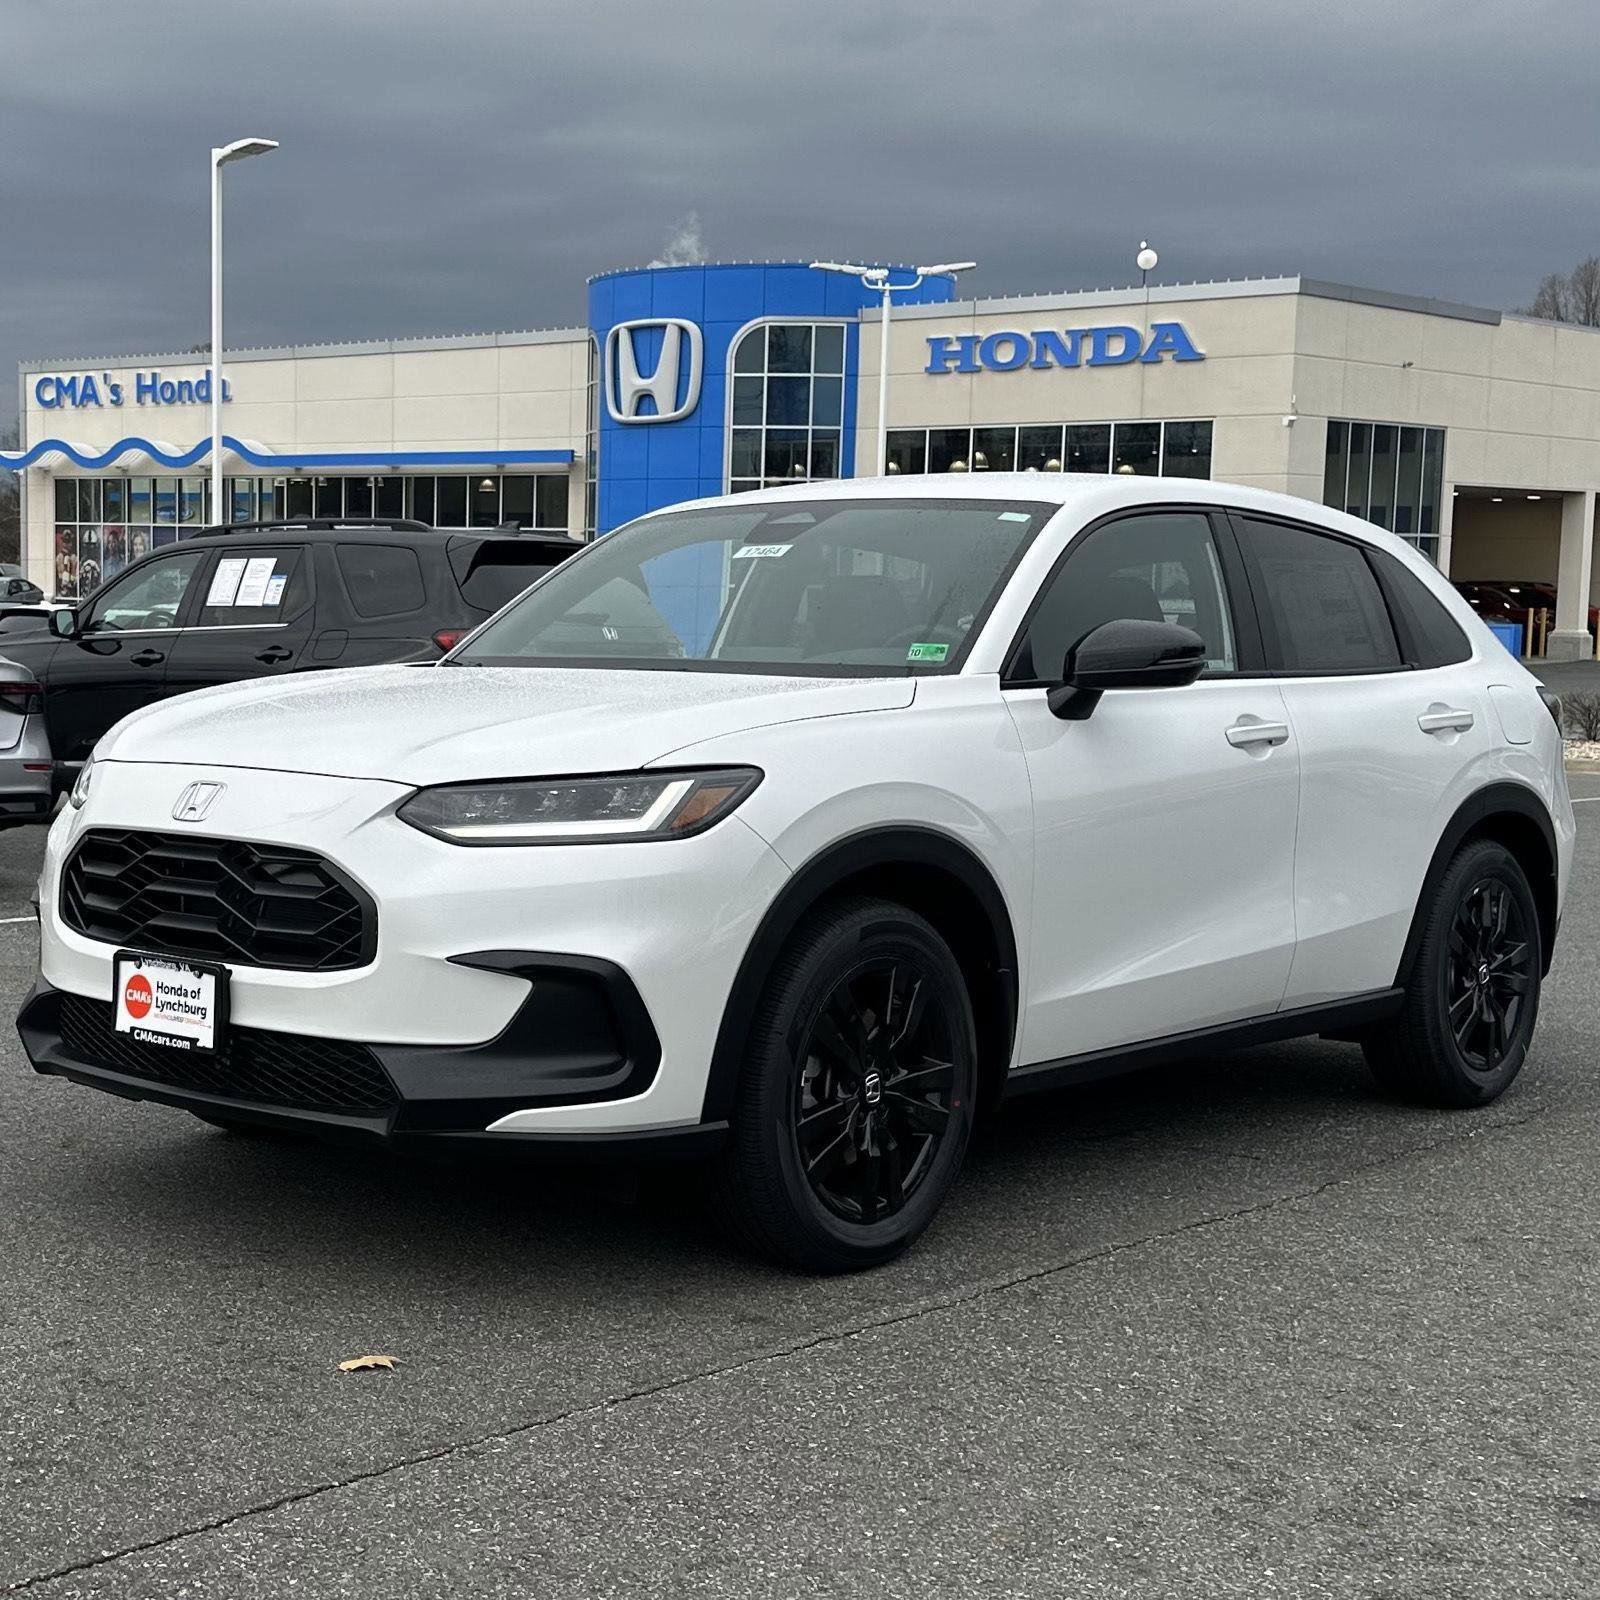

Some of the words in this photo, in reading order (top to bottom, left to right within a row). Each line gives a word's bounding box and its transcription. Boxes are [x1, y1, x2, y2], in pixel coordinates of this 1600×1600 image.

[925, 322, 1206, 374] HONDA
[36, 373, 123, 409] CMA's
[910, 649, 921, 657] 10
[156, 980, 188, 998] Honda
[190, 987, 202, 999] of
[155, 996, 207, 1019] Lynchburg
[133, 1029, 191, 1050] CMAcars.com
